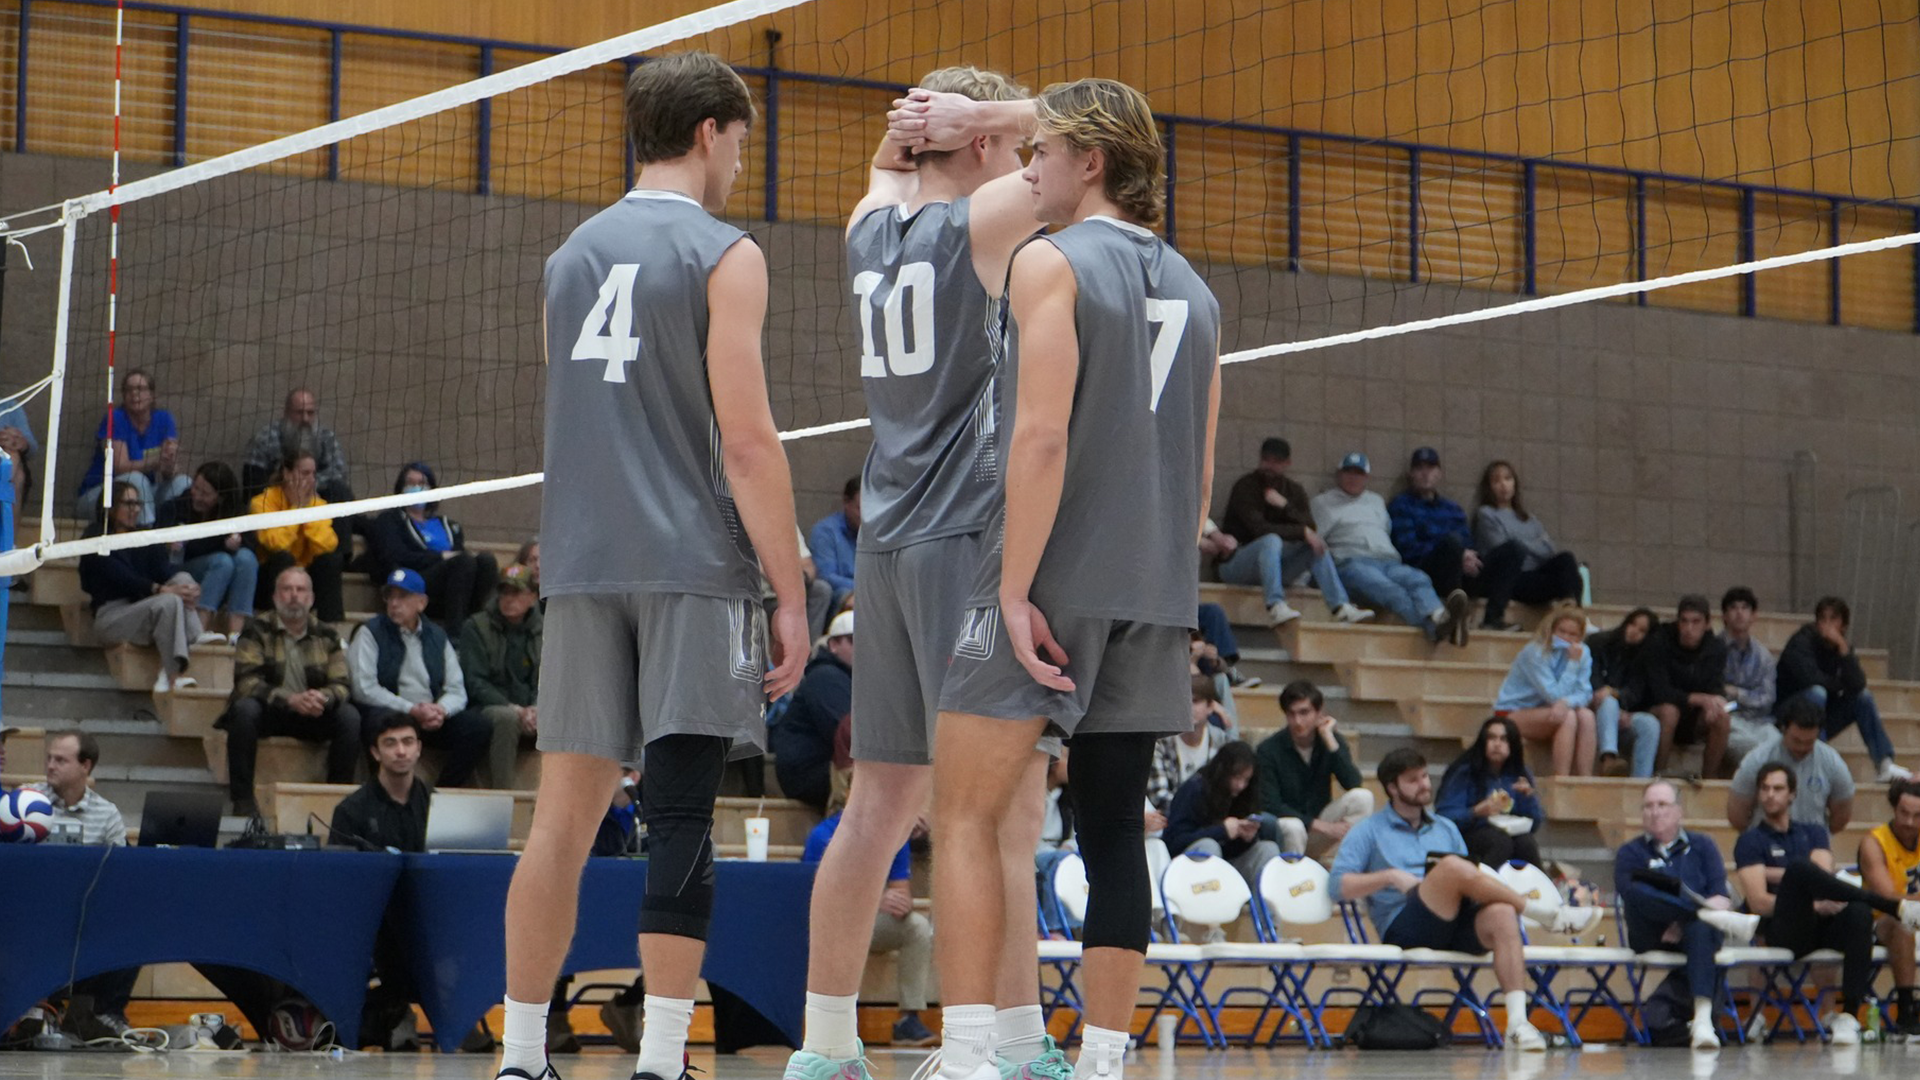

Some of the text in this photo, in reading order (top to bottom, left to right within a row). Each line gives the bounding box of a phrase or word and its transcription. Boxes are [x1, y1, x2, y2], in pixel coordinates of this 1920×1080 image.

[571, 263, 640, 383] 4
[853, 261, 935, 378] 10
[1145, 297, 1189, 414] 7
